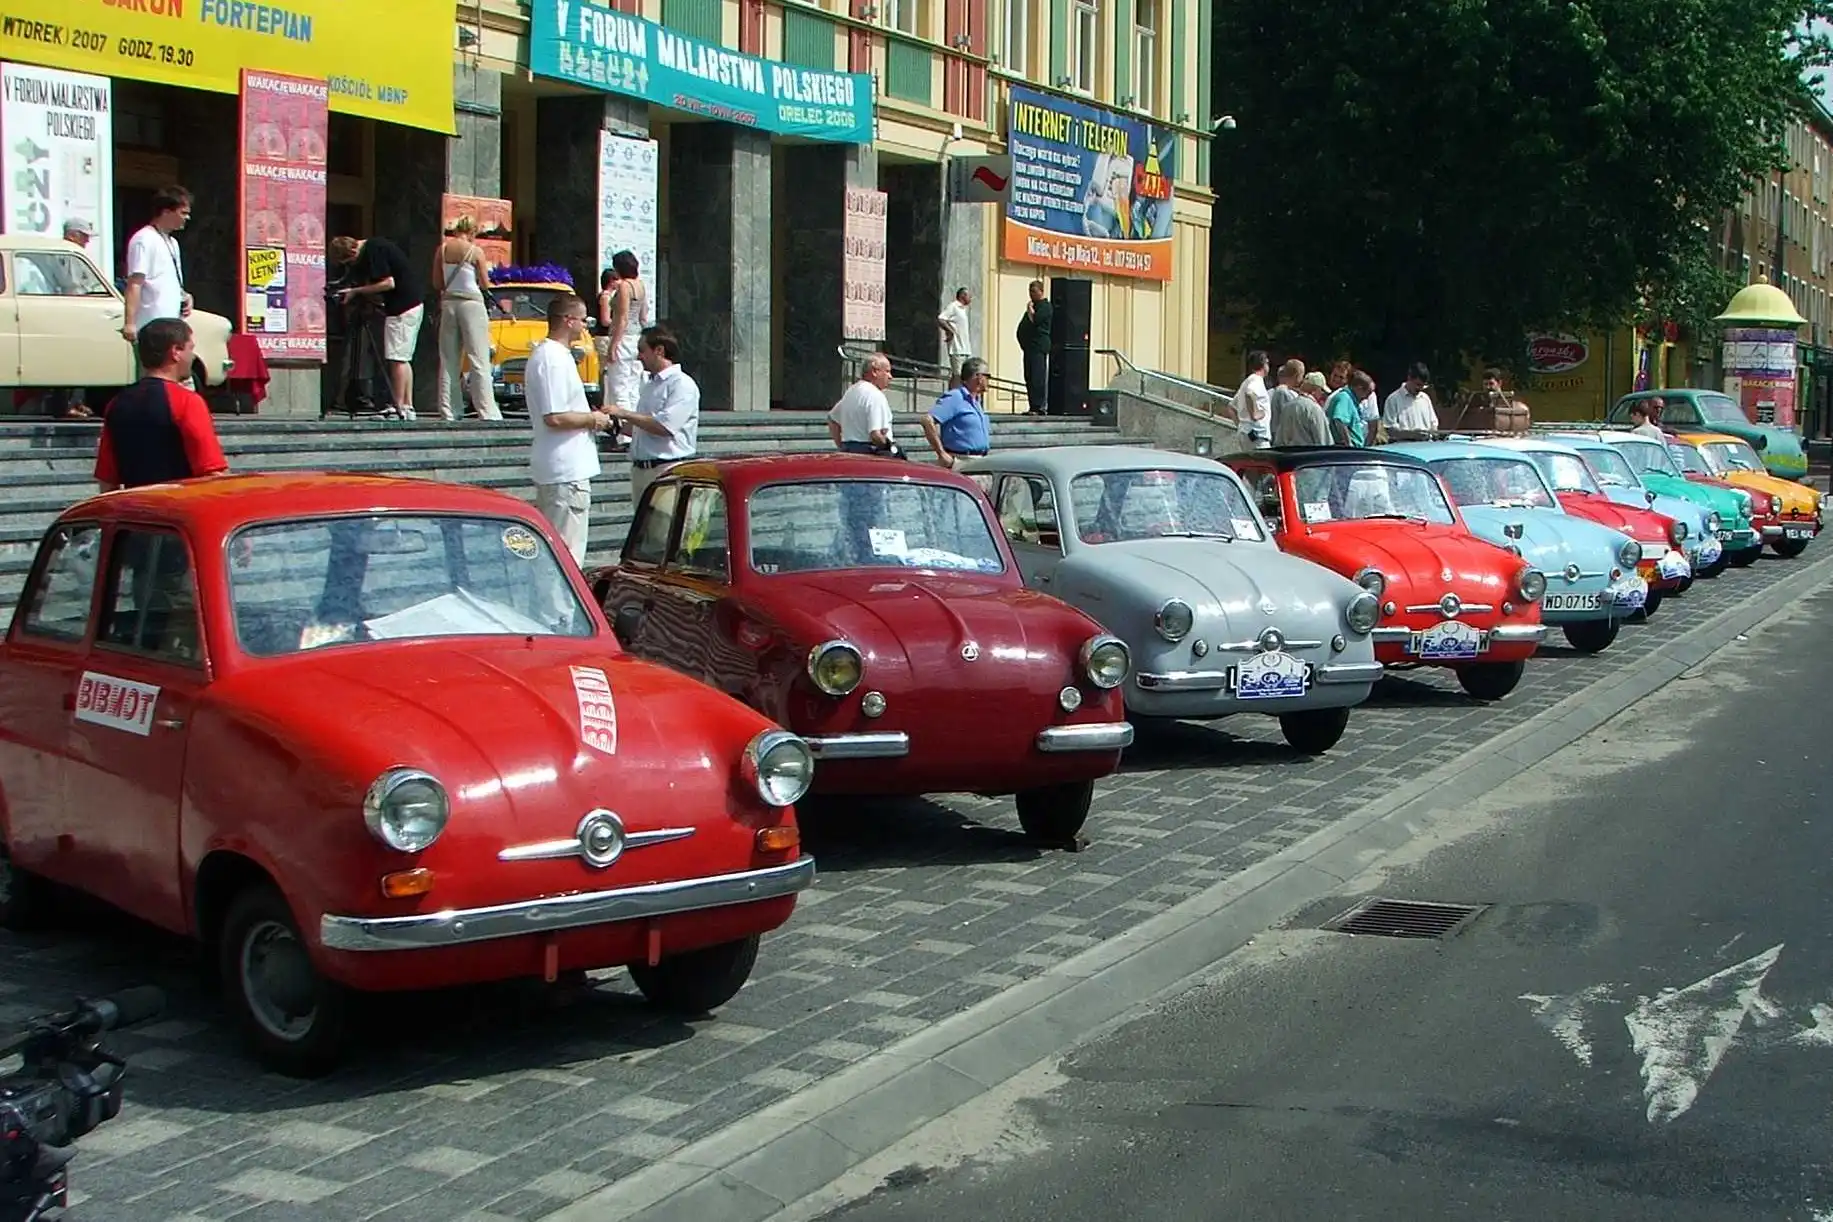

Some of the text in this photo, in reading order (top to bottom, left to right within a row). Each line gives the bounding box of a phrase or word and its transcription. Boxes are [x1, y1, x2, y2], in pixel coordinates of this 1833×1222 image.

[201, 0, 312, 42] FORTEPIAN
[72, 29, 107, 52] 2007
[158, 44, 194, 66] 19.30
[580, 5, 647, 58] FORUM
[657, 29, 766, 95] MALARSTWA
[772, 64, 855, 107] POLSKIEGO
[14, 76, 48, 105] FORUM
[50, 81, 108, 112] MALARSTWA
[247, 75, 327, 98] WAKACJE WAKACJE
[46, 111, 96, 140] POLSKIEGO
[1013, 101, 1072, 143] INTERNET
[1075, 118, 1079, 145] i
[1082, 120, 1128, 157] TELEFON
[245, 163, 326, 182] WAKACJE WAKACJE
[249, 251, 277, 264] KINO
[287, 253, 326, 266] WAKACJE
[250, 261, 283, 279] LETNIE
[256, 338, 326, 350] AKACJE WAKACJE
[1546, 595, 1563, 609] WD
